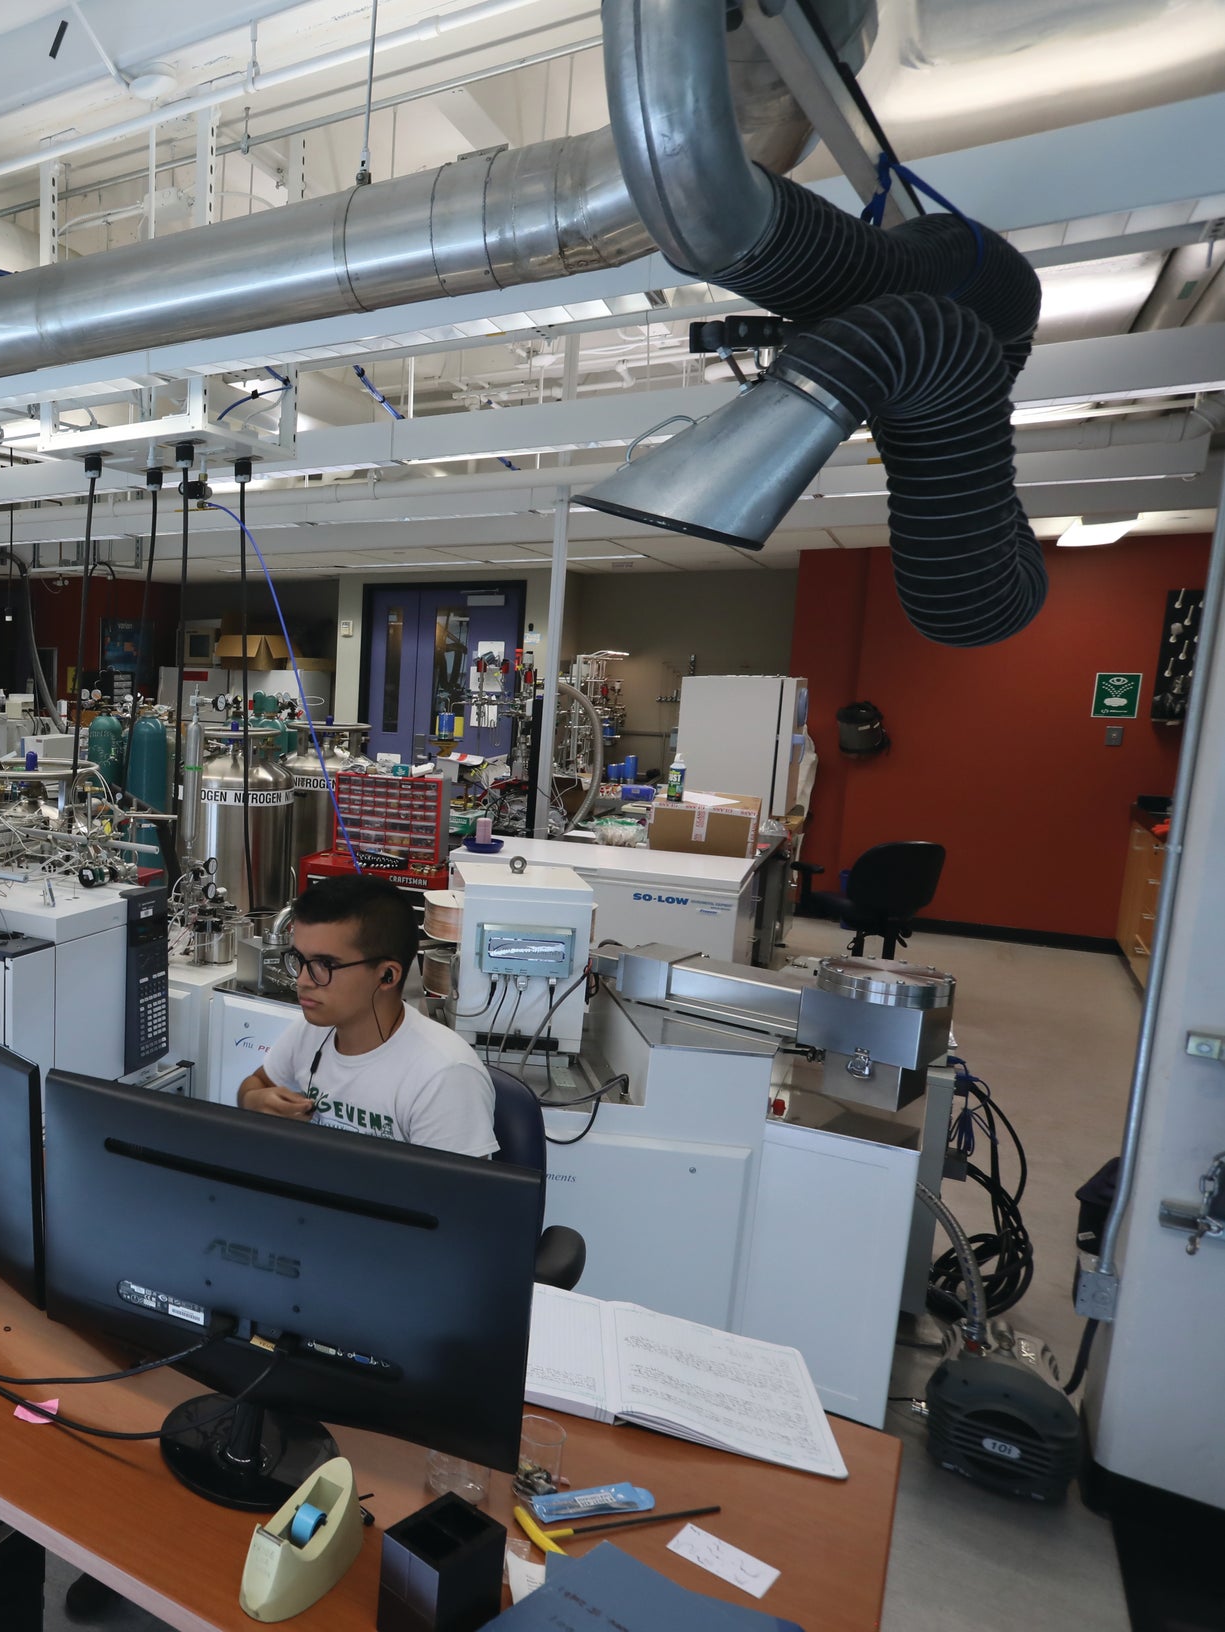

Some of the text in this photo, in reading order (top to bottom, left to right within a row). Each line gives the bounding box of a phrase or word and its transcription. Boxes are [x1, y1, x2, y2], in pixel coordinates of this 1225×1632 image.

[388, 875, 428, 886] CRAFTSMAN
[633, 893, 689, 905] SO-LOW
[203, 1239, 302, 1279] ASUS
[991, 1441, 1013, 1455] 10i
